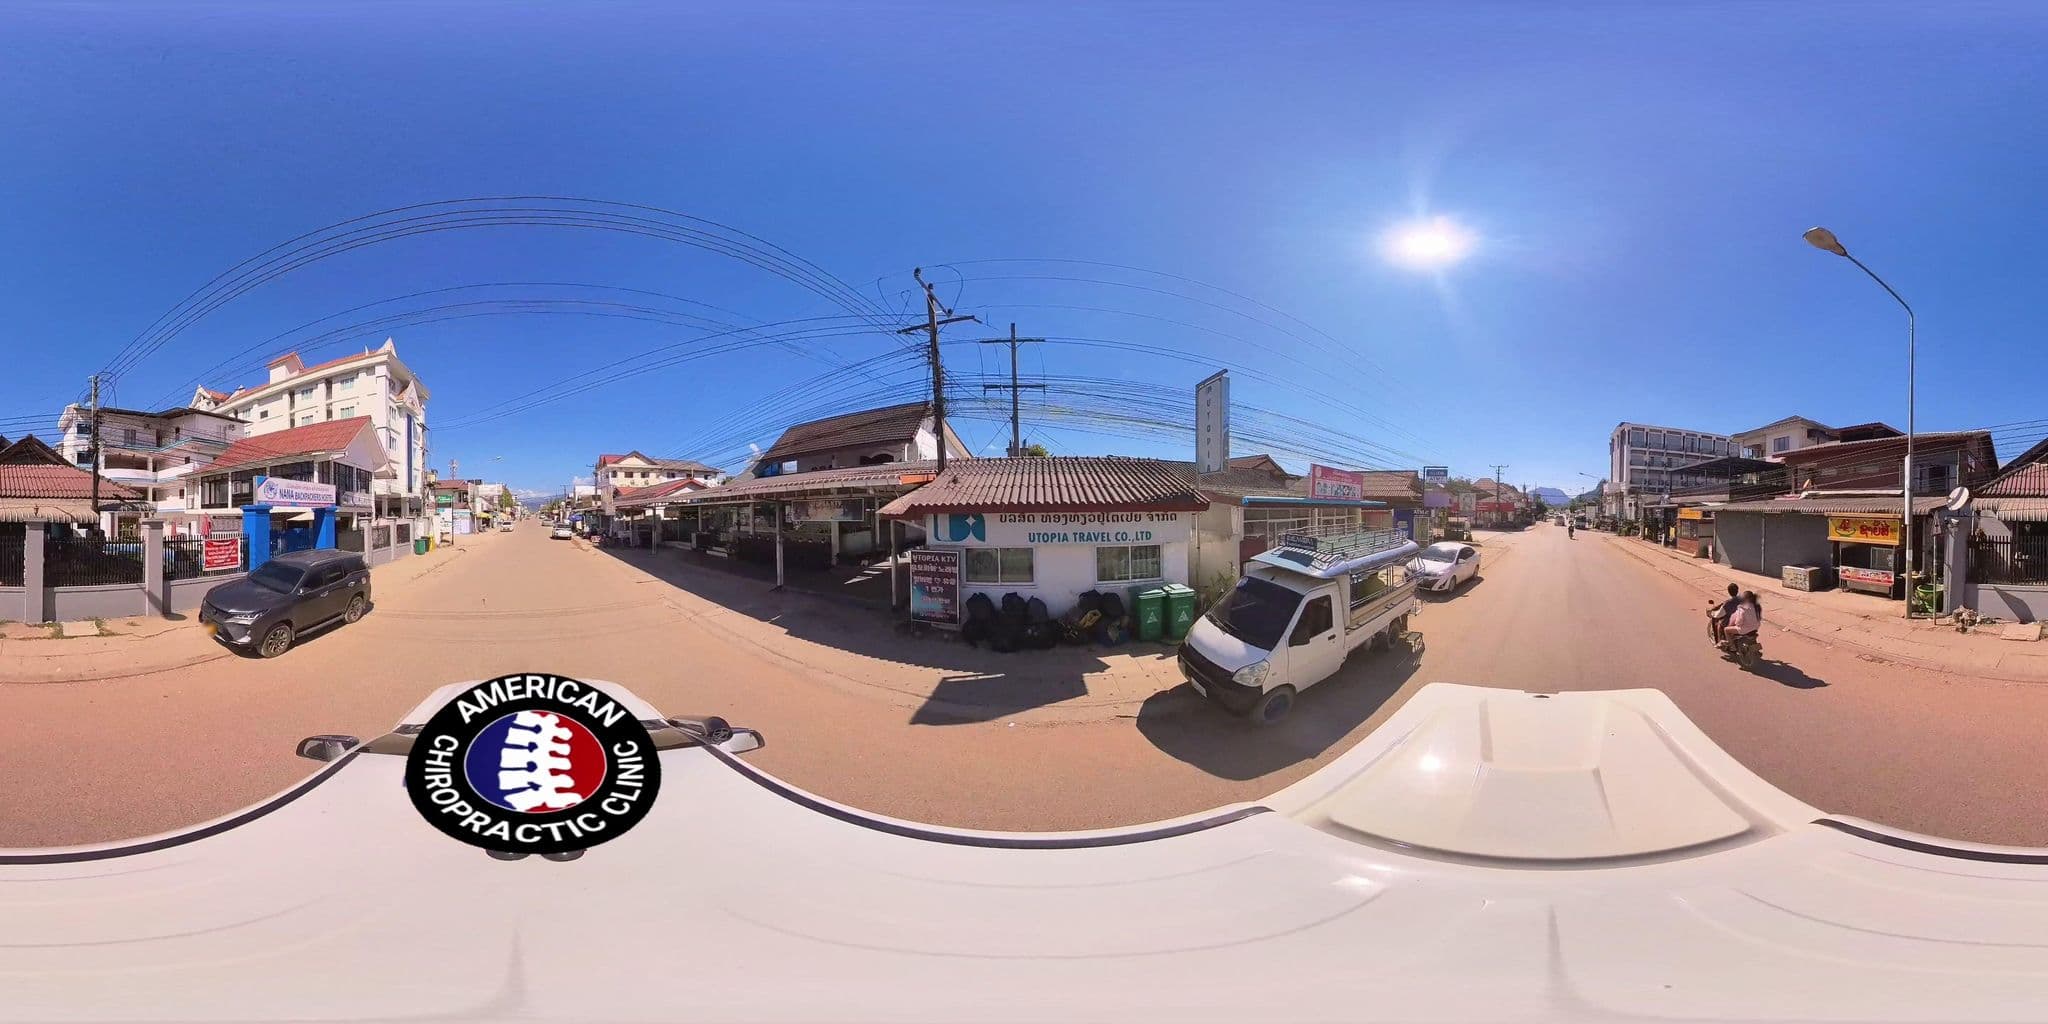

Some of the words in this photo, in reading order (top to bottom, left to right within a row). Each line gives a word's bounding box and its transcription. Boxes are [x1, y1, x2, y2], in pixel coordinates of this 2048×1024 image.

[279, 487, 295, 500] NANA
[1028, 532, 1069, 543] UTOPIA
[1072, 532, 1112, 543] TRAVEL
[1114, 531, 1152, 543] CO.,LTD
